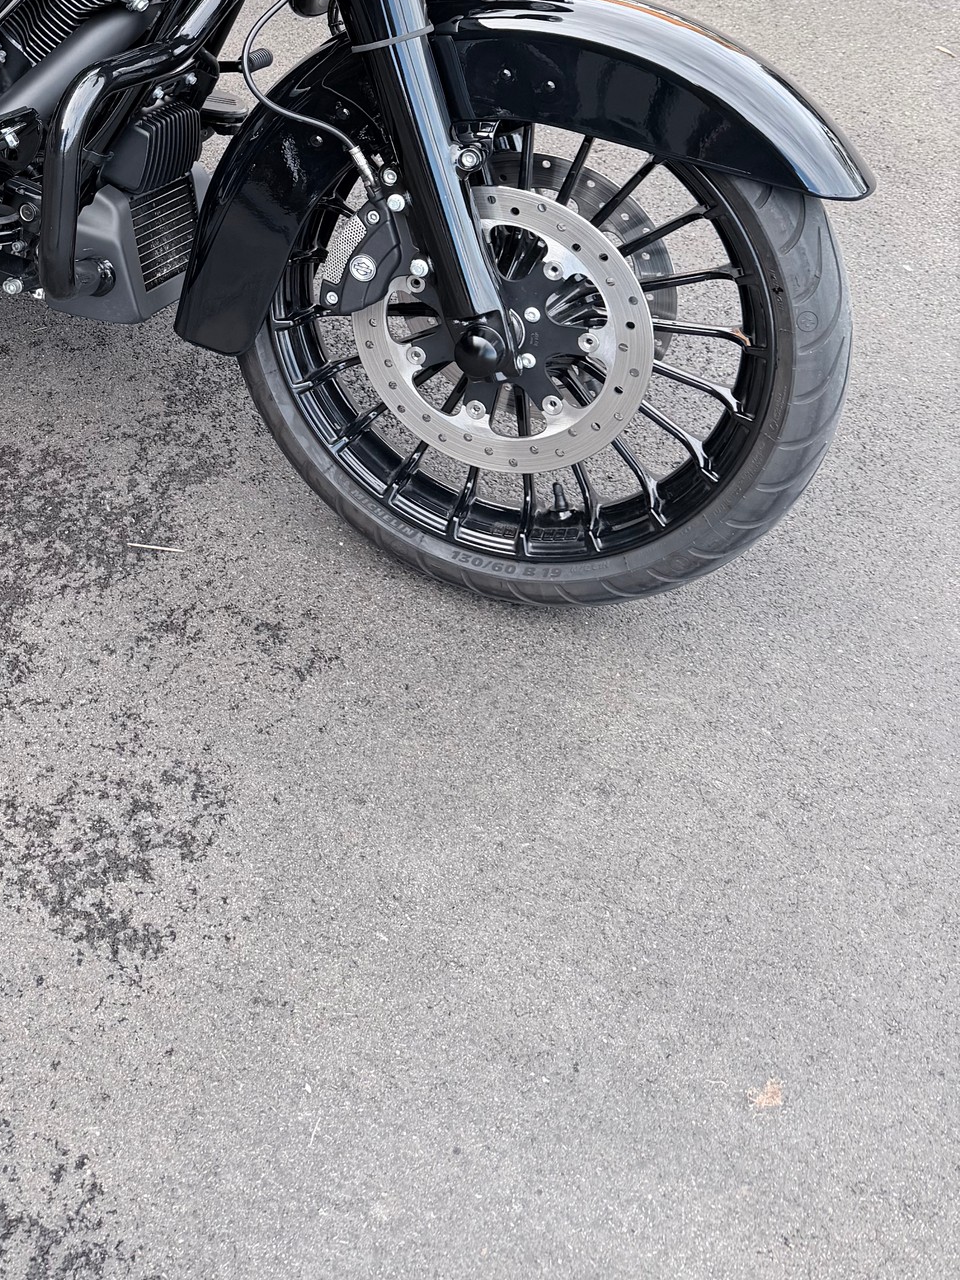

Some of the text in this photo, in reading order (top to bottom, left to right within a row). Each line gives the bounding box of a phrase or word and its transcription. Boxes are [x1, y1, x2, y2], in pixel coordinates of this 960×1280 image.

[350, 489, 415, 536] MICHELIN
[451, 551, 517, 575] 130/60
[522, 566, 536, 577] B
[541, 567, 562, 578] 19
